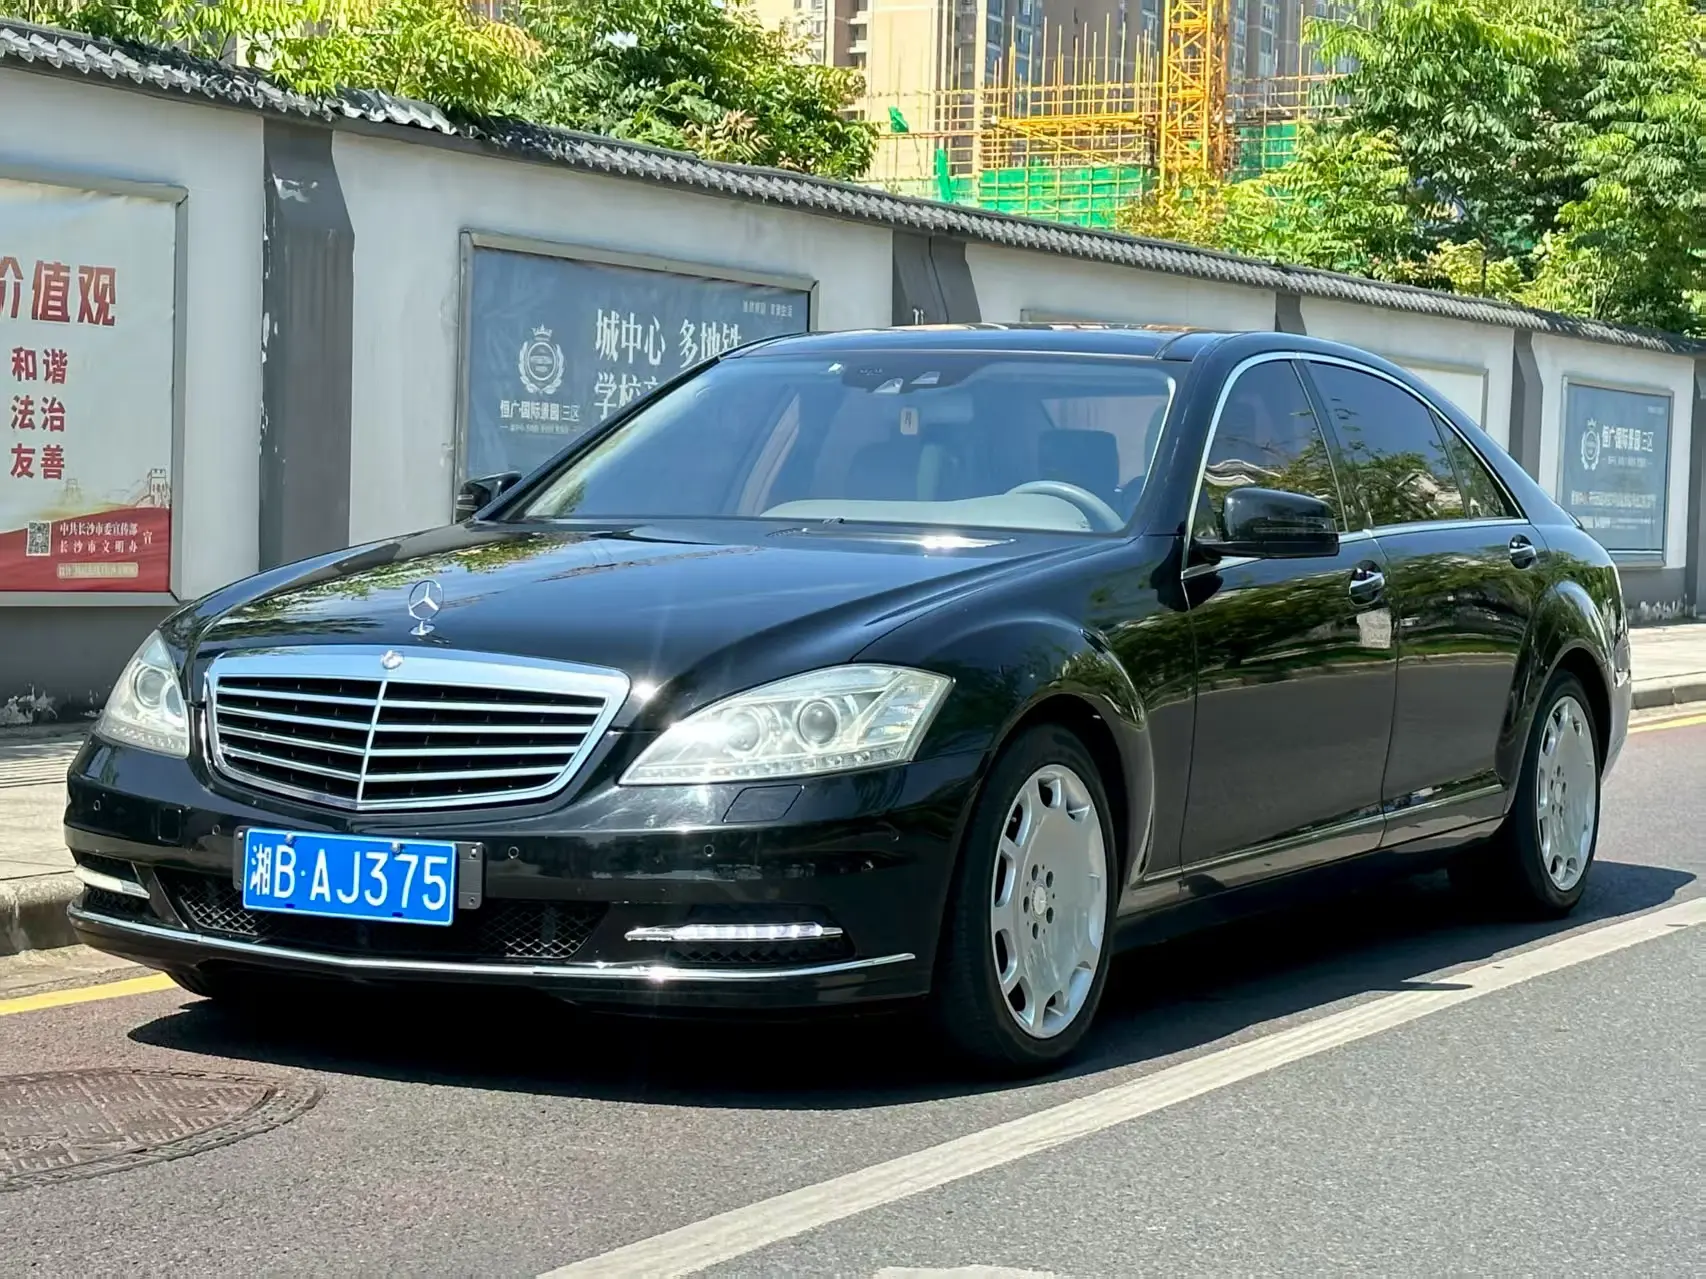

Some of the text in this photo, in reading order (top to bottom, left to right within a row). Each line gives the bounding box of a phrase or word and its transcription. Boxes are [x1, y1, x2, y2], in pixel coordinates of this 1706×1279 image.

[0, 256, 116, 326] 价值观
[595, 309, 741, 368] 城中心 多地铁
[12, 346, 68, 384] 和谐
[11, 395, 65, 432] 法治
[594, 372, 660, 421] 学校
[10, 443, 65, 480] 友善
[60, 522, 138, 536] 中共长沙市委宣传部
[60, 540, 138, 554] 长沙市文明办
